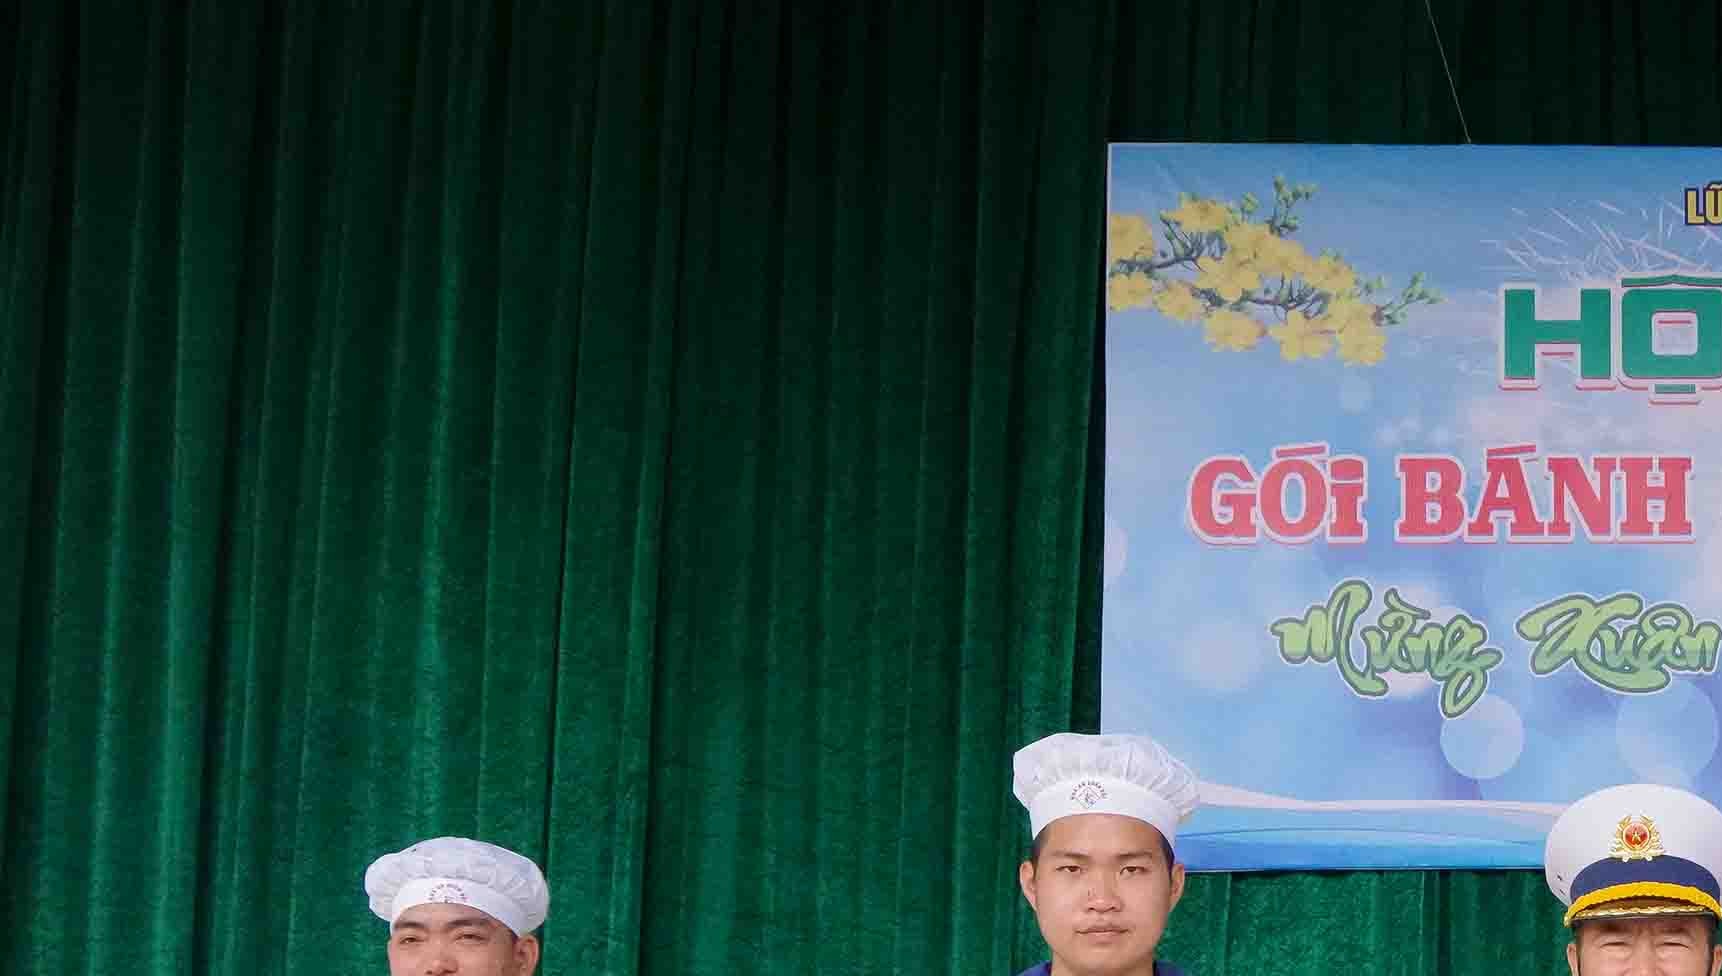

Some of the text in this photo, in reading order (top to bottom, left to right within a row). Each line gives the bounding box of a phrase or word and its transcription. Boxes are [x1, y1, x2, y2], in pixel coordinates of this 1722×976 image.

[1396, 443, 1694, 541] BÁNH
[1271, 579, 1502, 718] Mừng
[1516, 592, 1722, 692] Xuân
